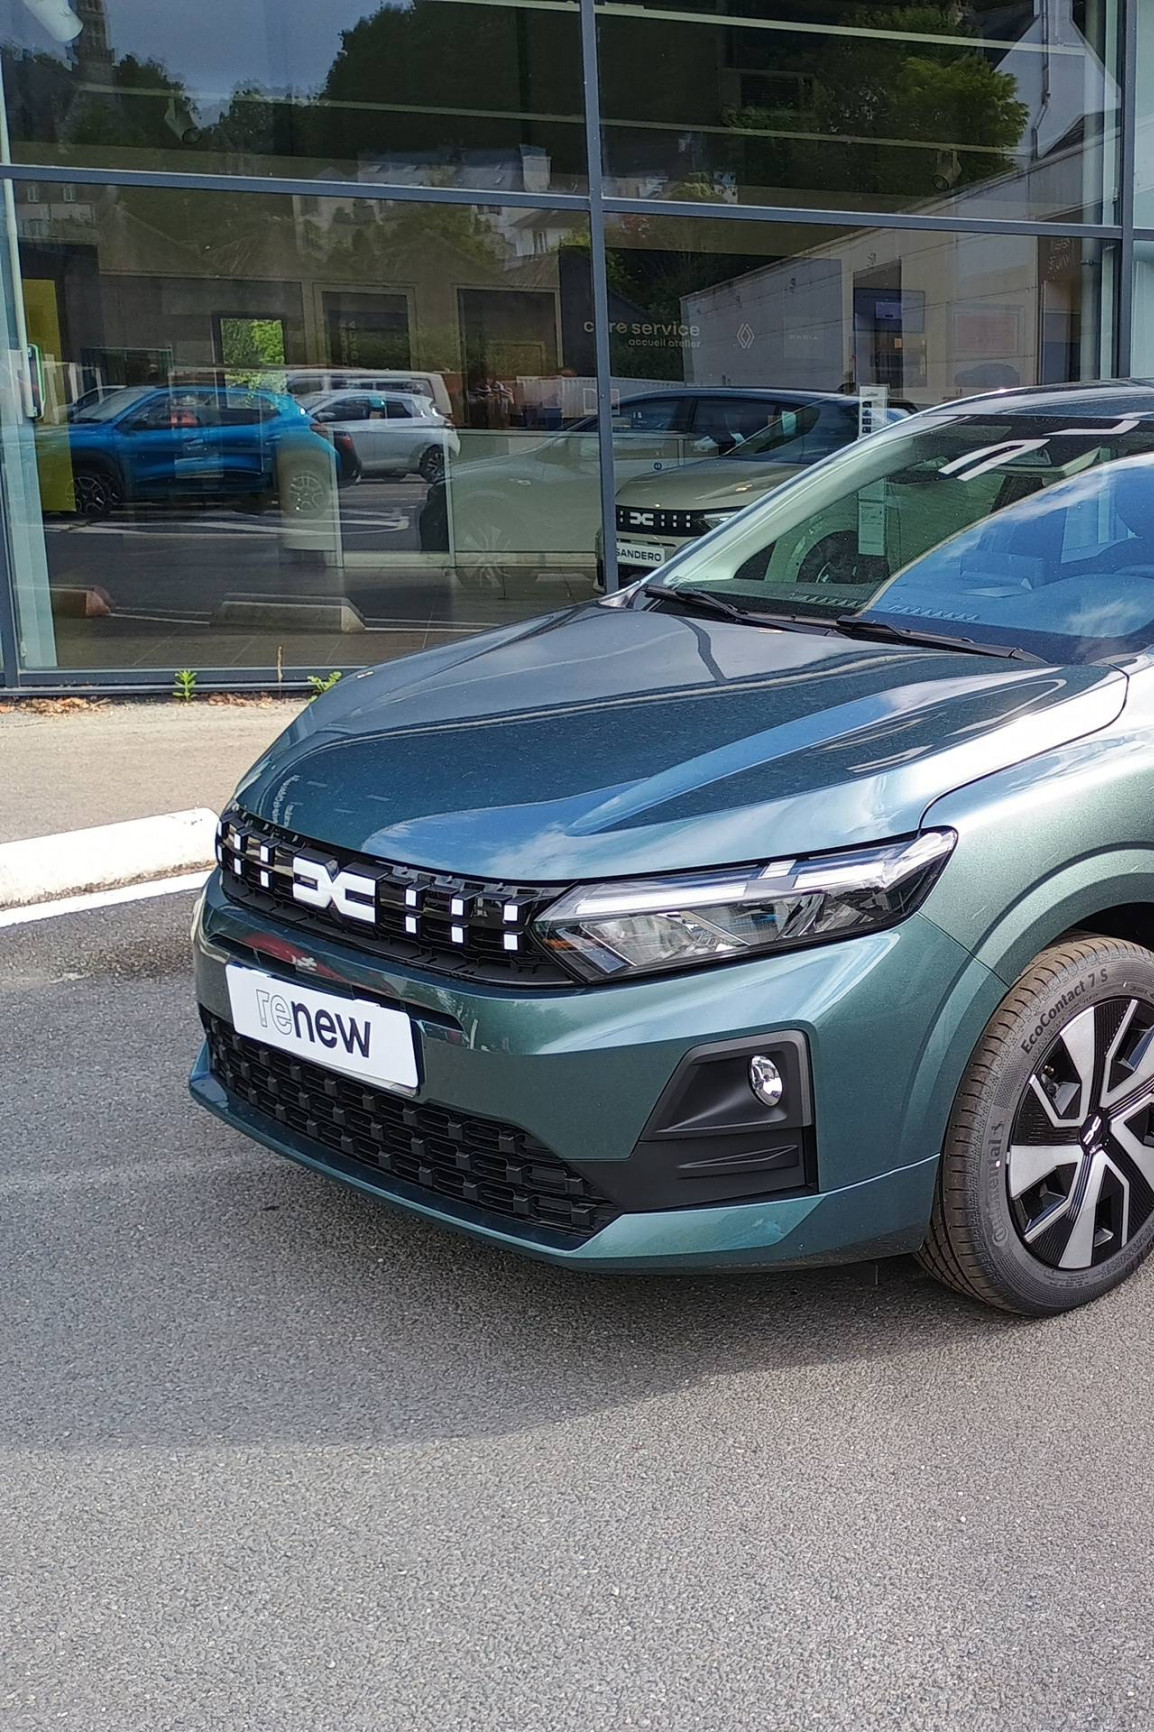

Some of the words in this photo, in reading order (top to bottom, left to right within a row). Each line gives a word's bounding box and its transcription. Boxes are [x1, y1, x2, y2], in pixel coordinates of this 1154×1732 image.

[583, 320, 628, 334] cre
[631, 321, 700, 337] service
[628, 338, 666, 348] accueil
[667, 340, 700, 349] atelier
[615, 548, 662, 562] SANDERO
[1020, 979, 1086, 1055] EcoContact
[1087, 972, 1096, 988] 7
[1100, 968, 1109, 983] S
[255, 988, 371, 1059] renew
